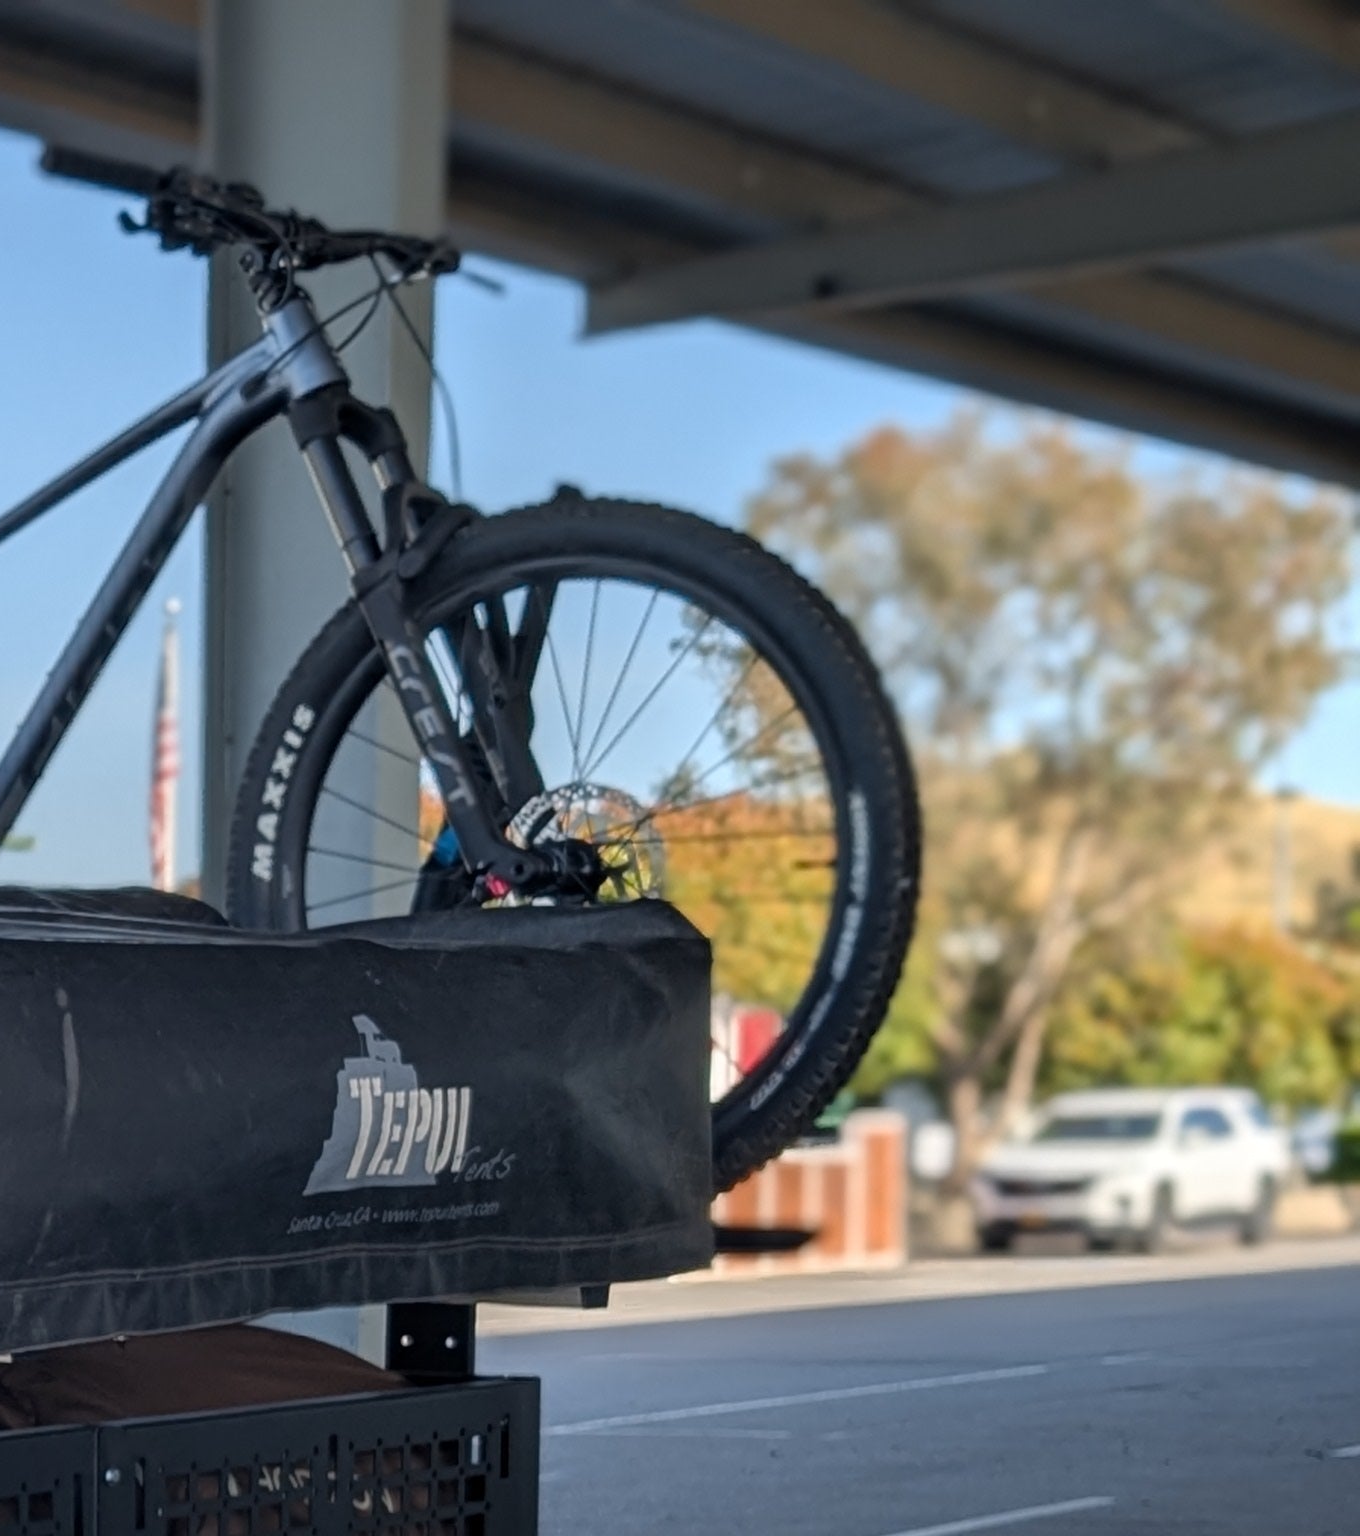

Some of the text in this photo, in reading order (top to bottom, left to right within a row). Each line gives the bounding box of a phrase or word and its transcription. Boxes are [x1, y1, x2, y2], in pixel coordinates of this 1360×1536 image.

[250, 703, 316, 882] MAXXIS
[346, 1076, 471, 1180] TEPUI
[453, 1146, 518, 1183] Tents
